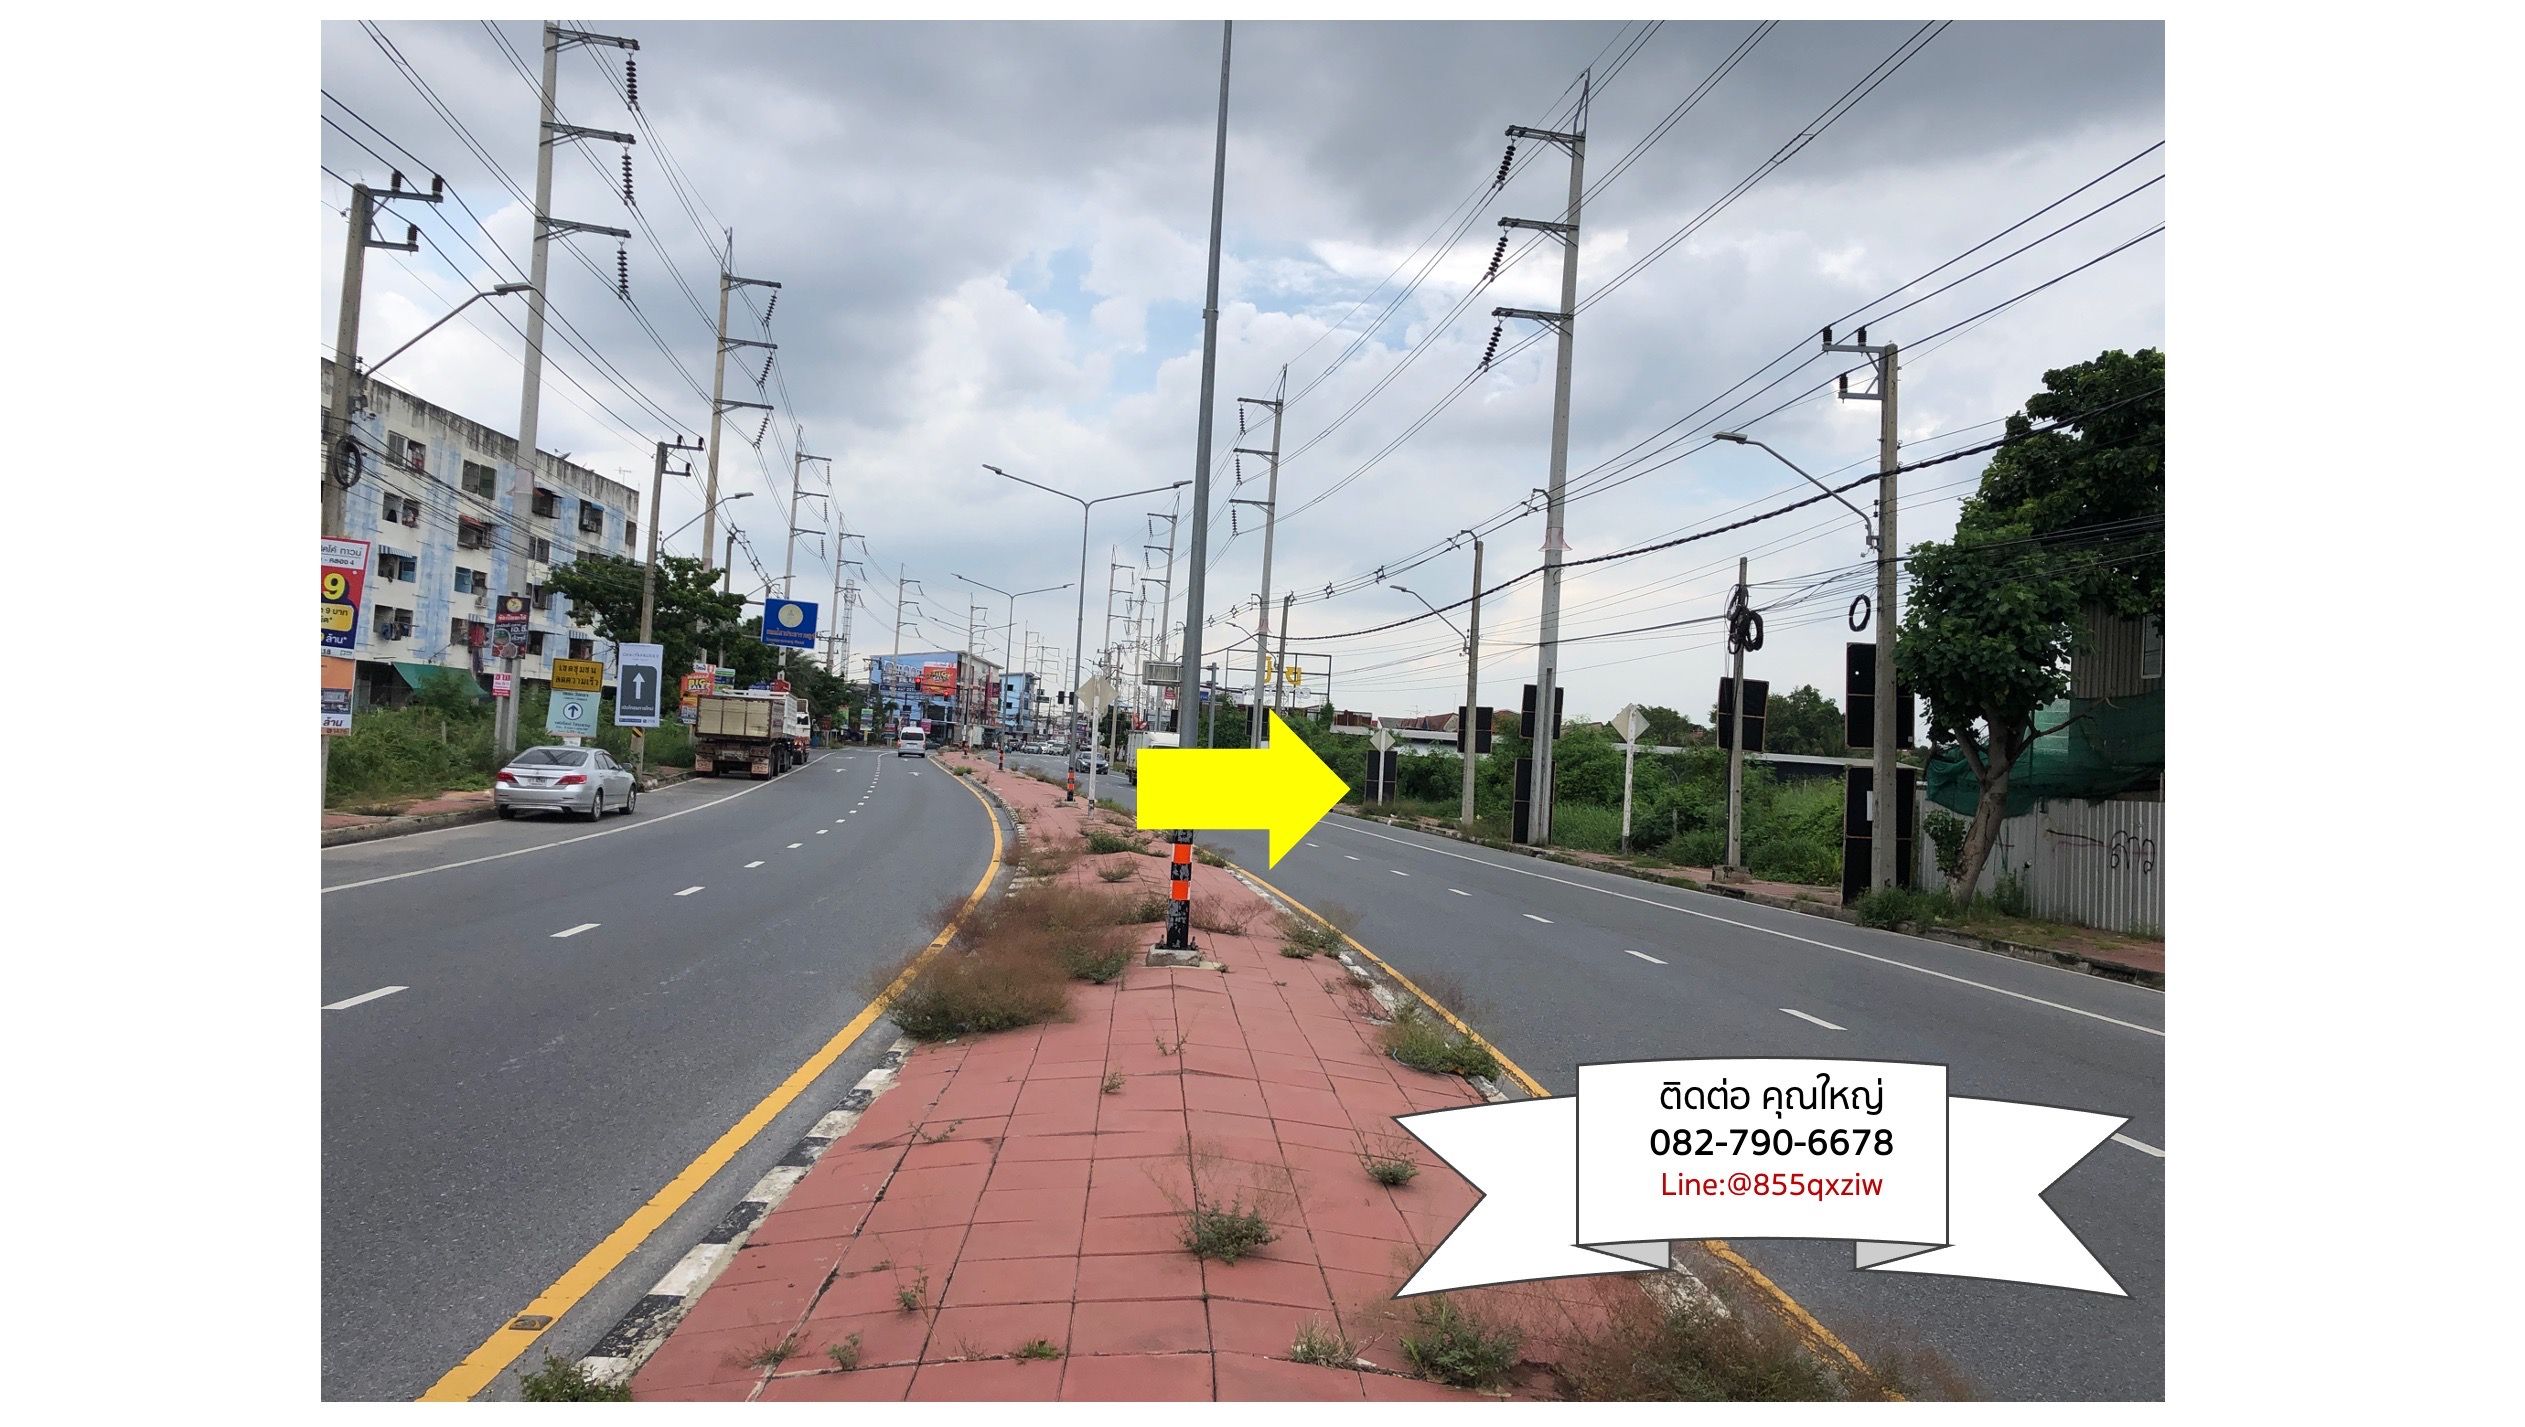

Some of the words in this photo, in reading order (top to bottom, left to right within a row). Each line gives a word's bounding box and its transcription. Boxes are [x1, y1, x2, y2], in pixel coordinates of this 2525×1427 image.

[323, 572, 346, 601] 9
[332, 608, 348, 616] บาท
[559, 664, 597, 675] เขตชุมชน
[555, 675, 599, 686] ลดความเร็ว
[323, 716, 343, 727] ล้าน
